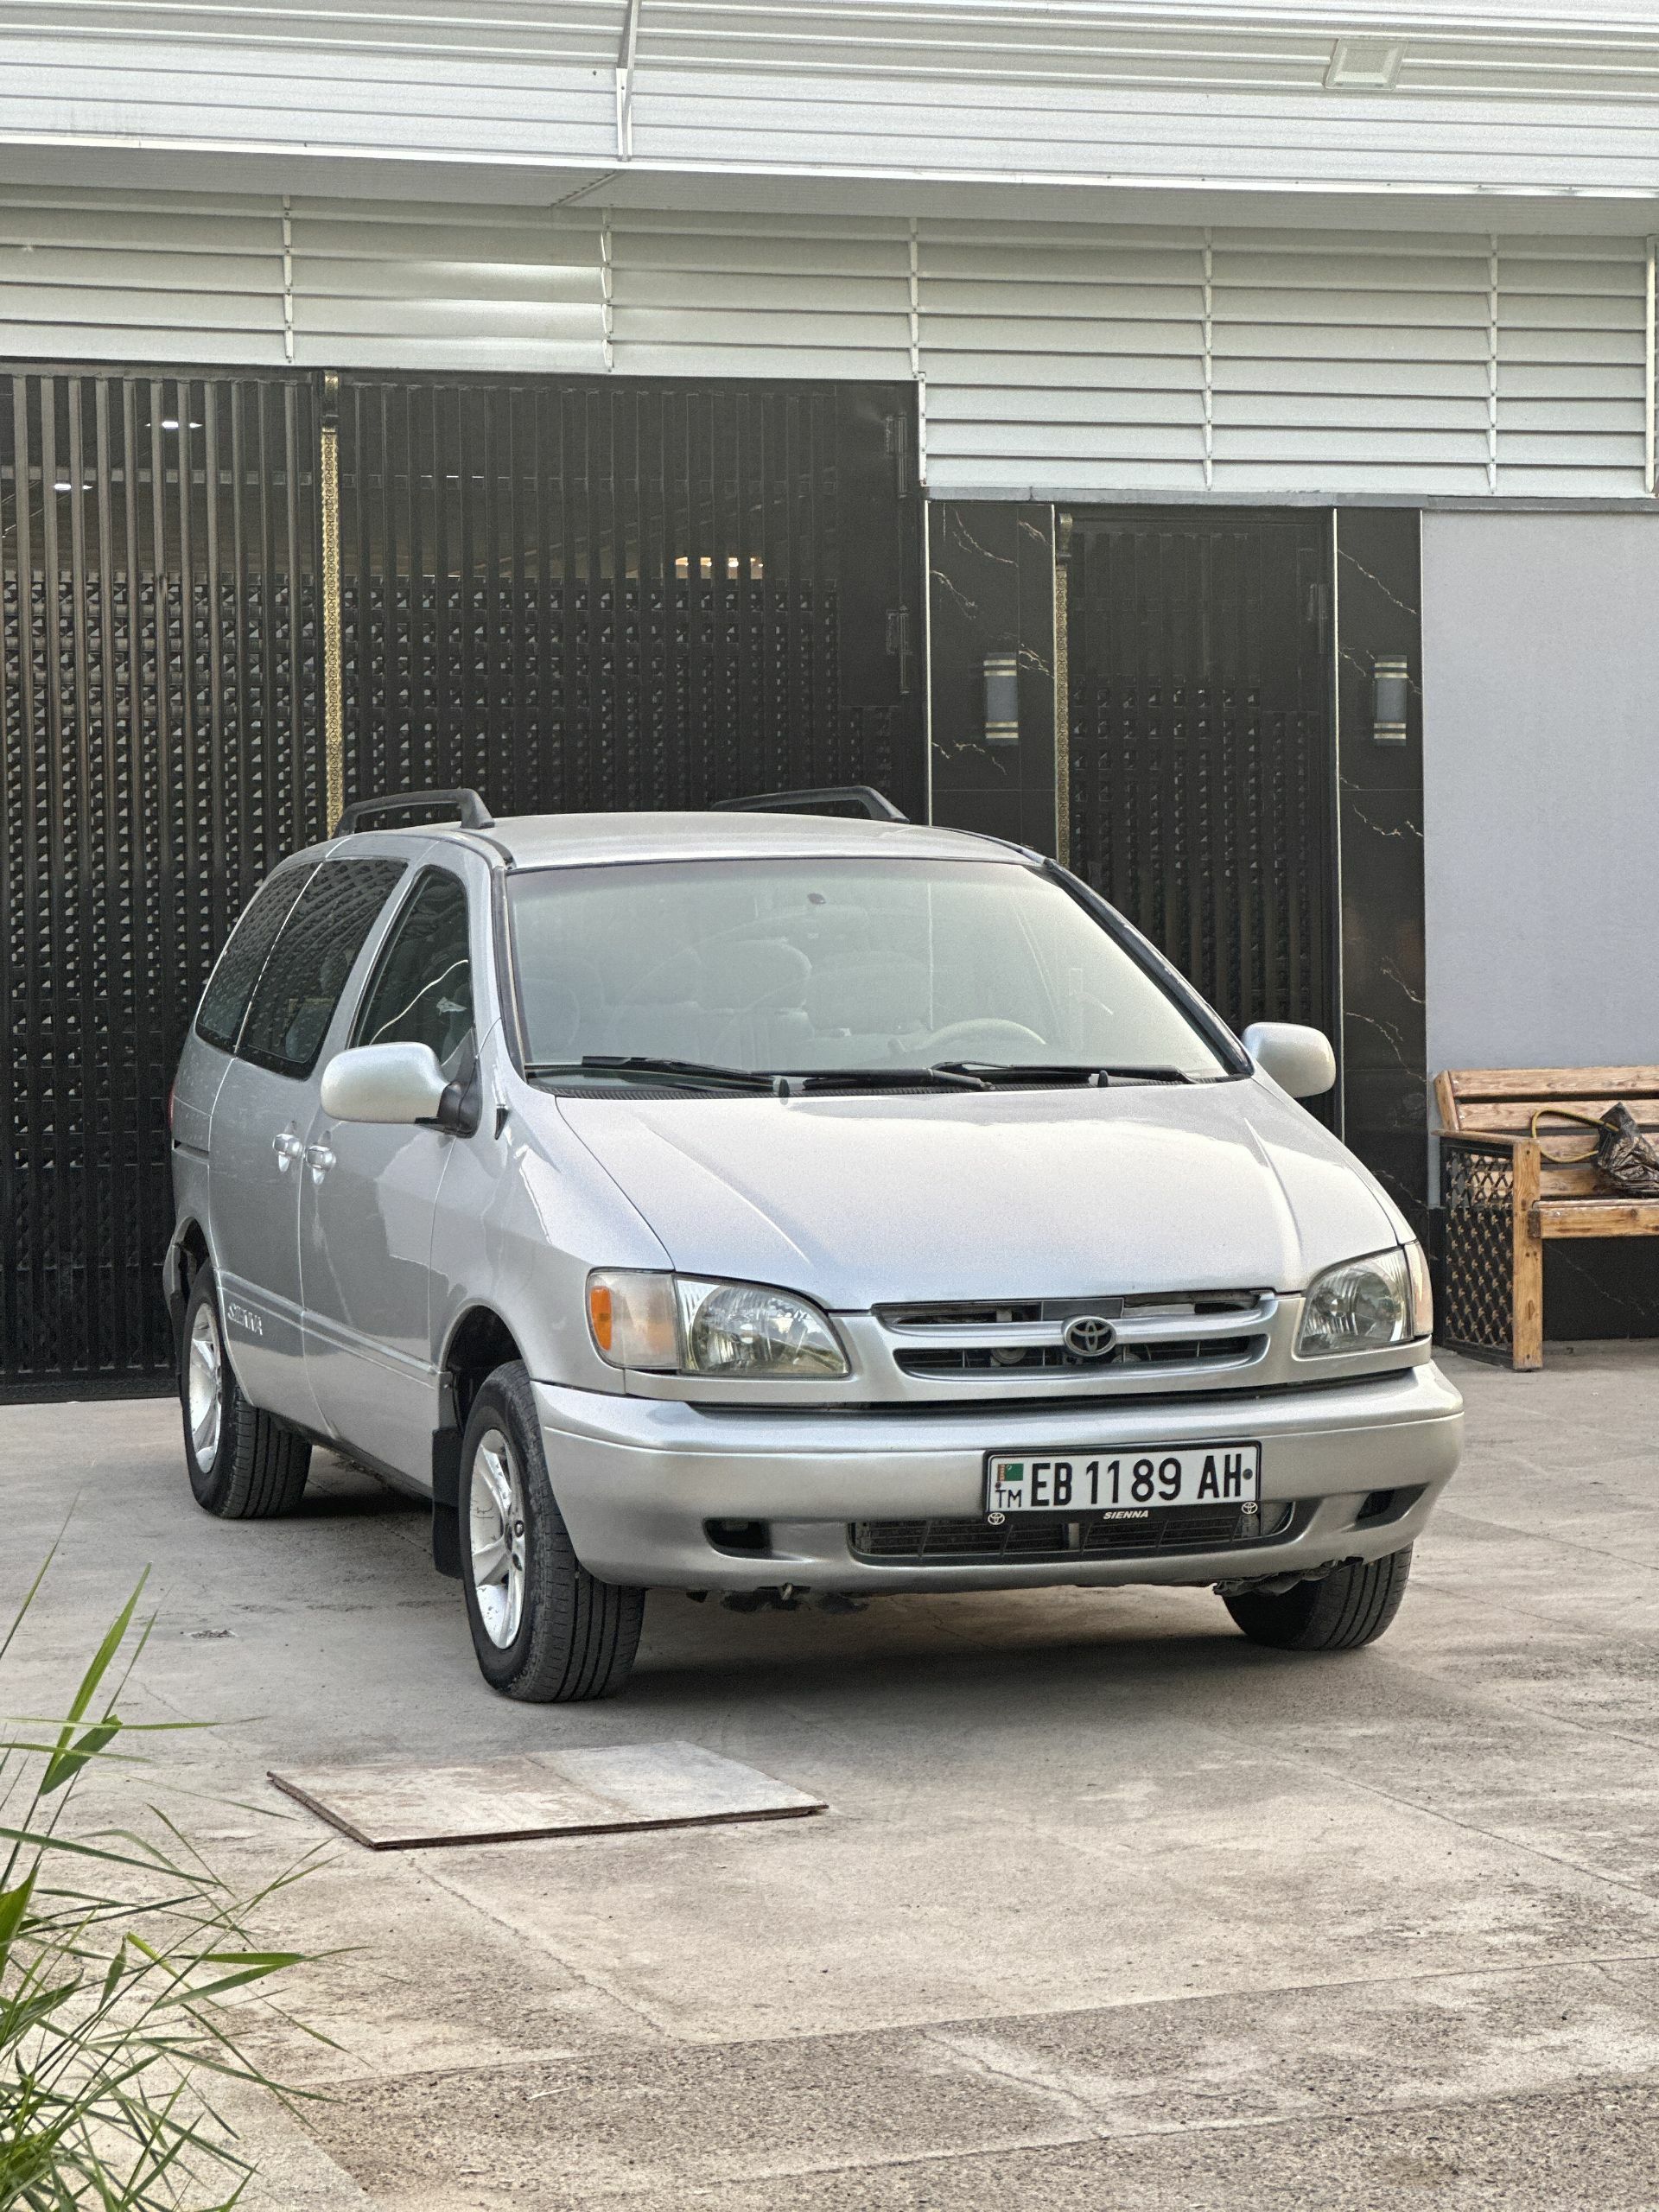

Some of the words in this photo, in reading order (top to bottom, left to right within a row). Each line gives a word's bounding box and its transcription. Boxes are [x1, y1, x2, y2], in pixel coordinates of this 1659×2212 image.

[1031, 1462, 1073, 1507] EB
[1085, 1457, 1182, 1504] 1189
[1197, 1453, 1242, 1499] AH
[995, 1488, 1022, 1509] TM
[1103, 1510, 1149, 1520] SIENNA
